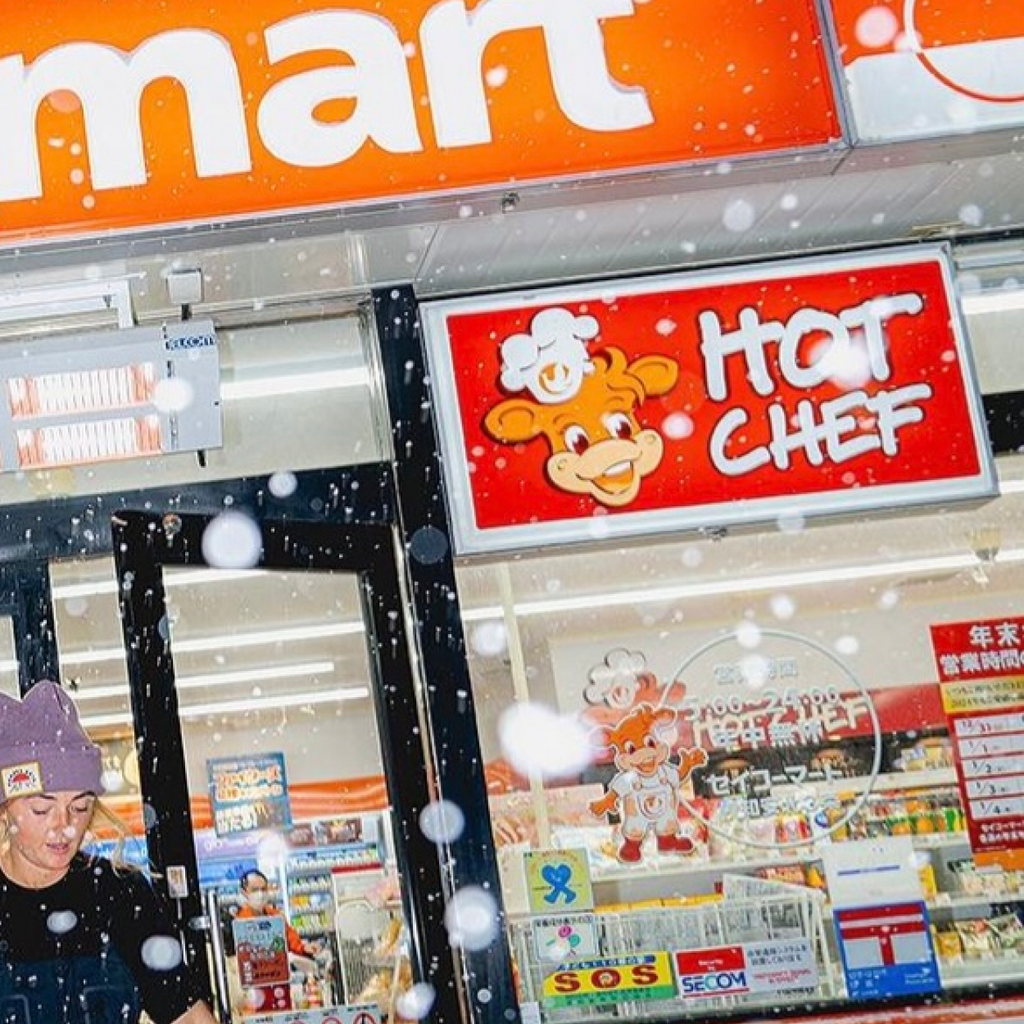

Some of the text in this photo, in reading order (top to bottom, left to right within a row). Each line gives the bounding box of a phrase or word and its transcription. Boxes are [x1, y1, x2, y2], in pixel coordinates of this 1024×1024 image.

[700, 292, 925, 402] HOT
[708, 382, 934, 478] CHEF
[969, 621, 1024, 650] 年末
[940, 648, 1024, 676] 営業時間
[702, 764, 843, 795] セイコーマート
[554, 964, 659, 993] SOS
[682, 972, 747, 993] SECOM
